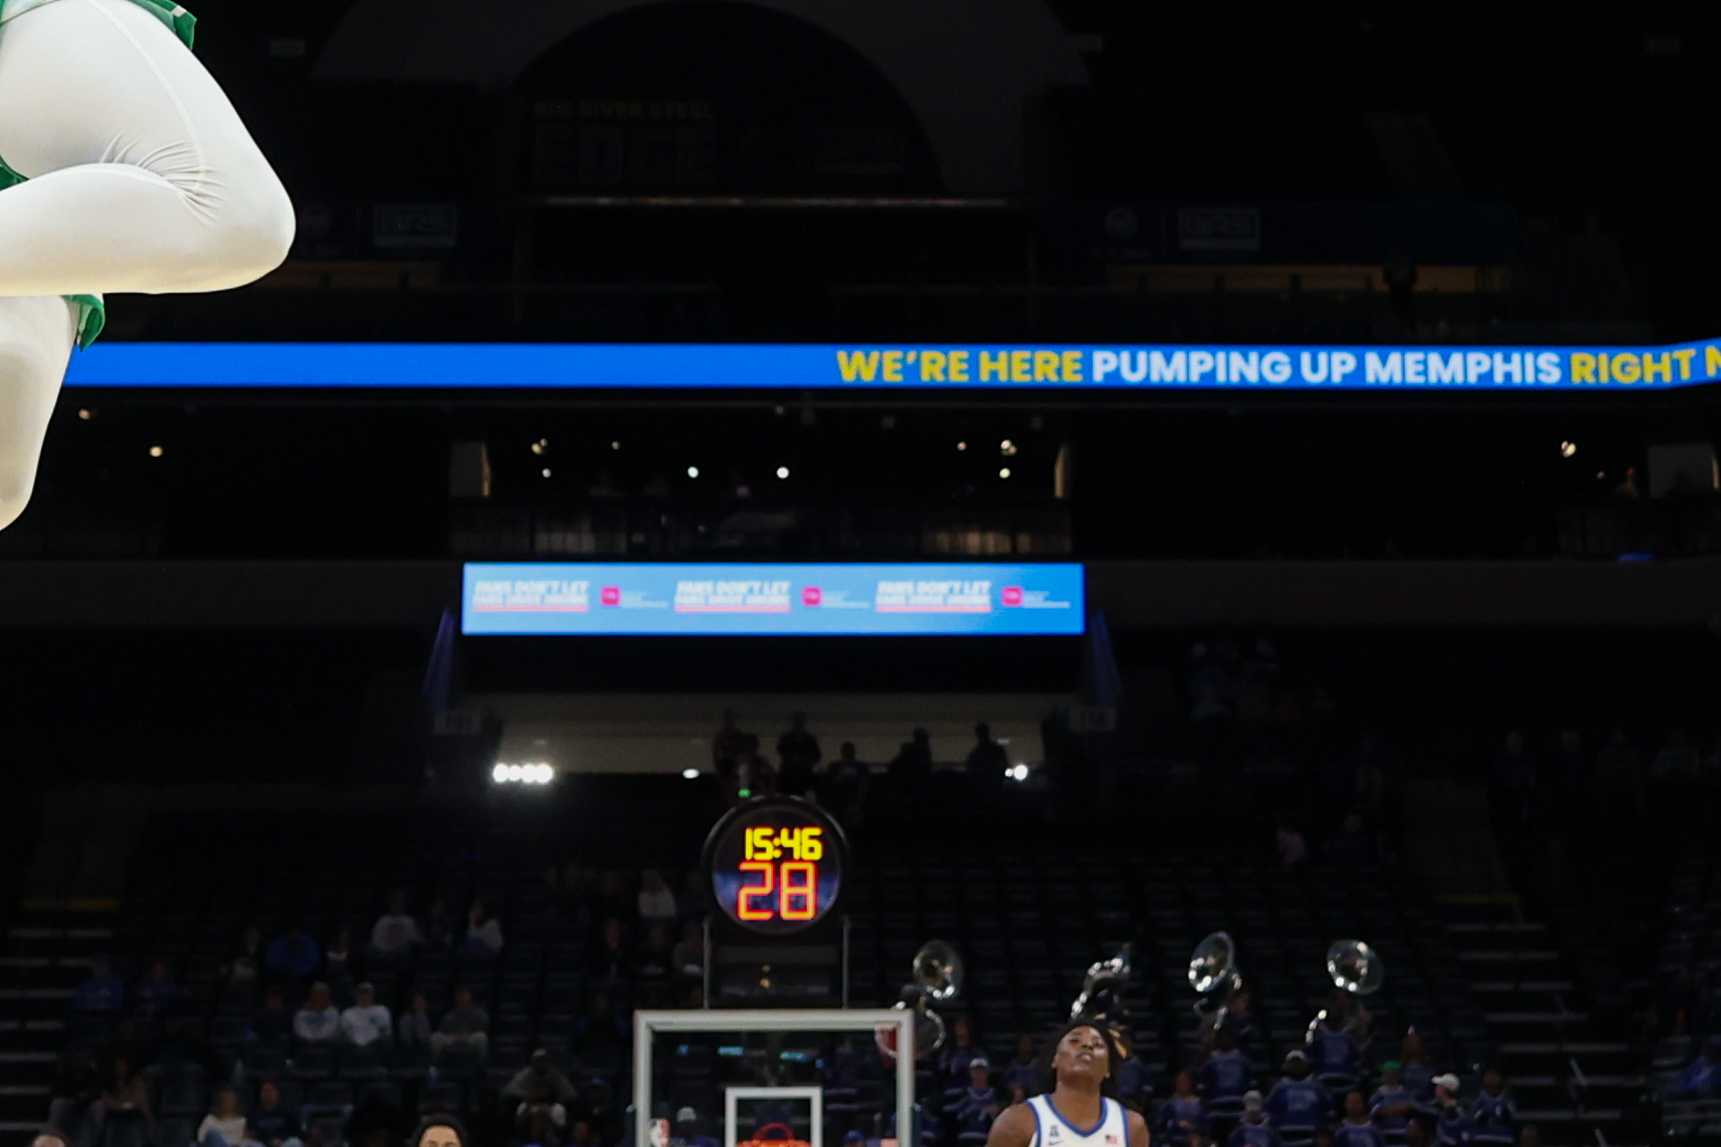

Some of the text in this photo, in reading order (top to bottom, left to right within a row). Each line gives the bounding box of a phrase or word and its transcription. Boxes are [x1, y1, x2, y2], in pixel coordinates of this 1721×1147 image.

[836, 350, 969, 382] WE'RE
[980, 350, 1083, 383] HERE
[1092, 351, 1292, 383] PUMPING
[1300, 351, 1357, 383] UP
[1365, 352, 1561, 384] MEMPHIS
[1571, 349, 1697, 384] RIGHT
[745, 827, 823, 861] 15:46
[736, 861, 817, 920] 28
